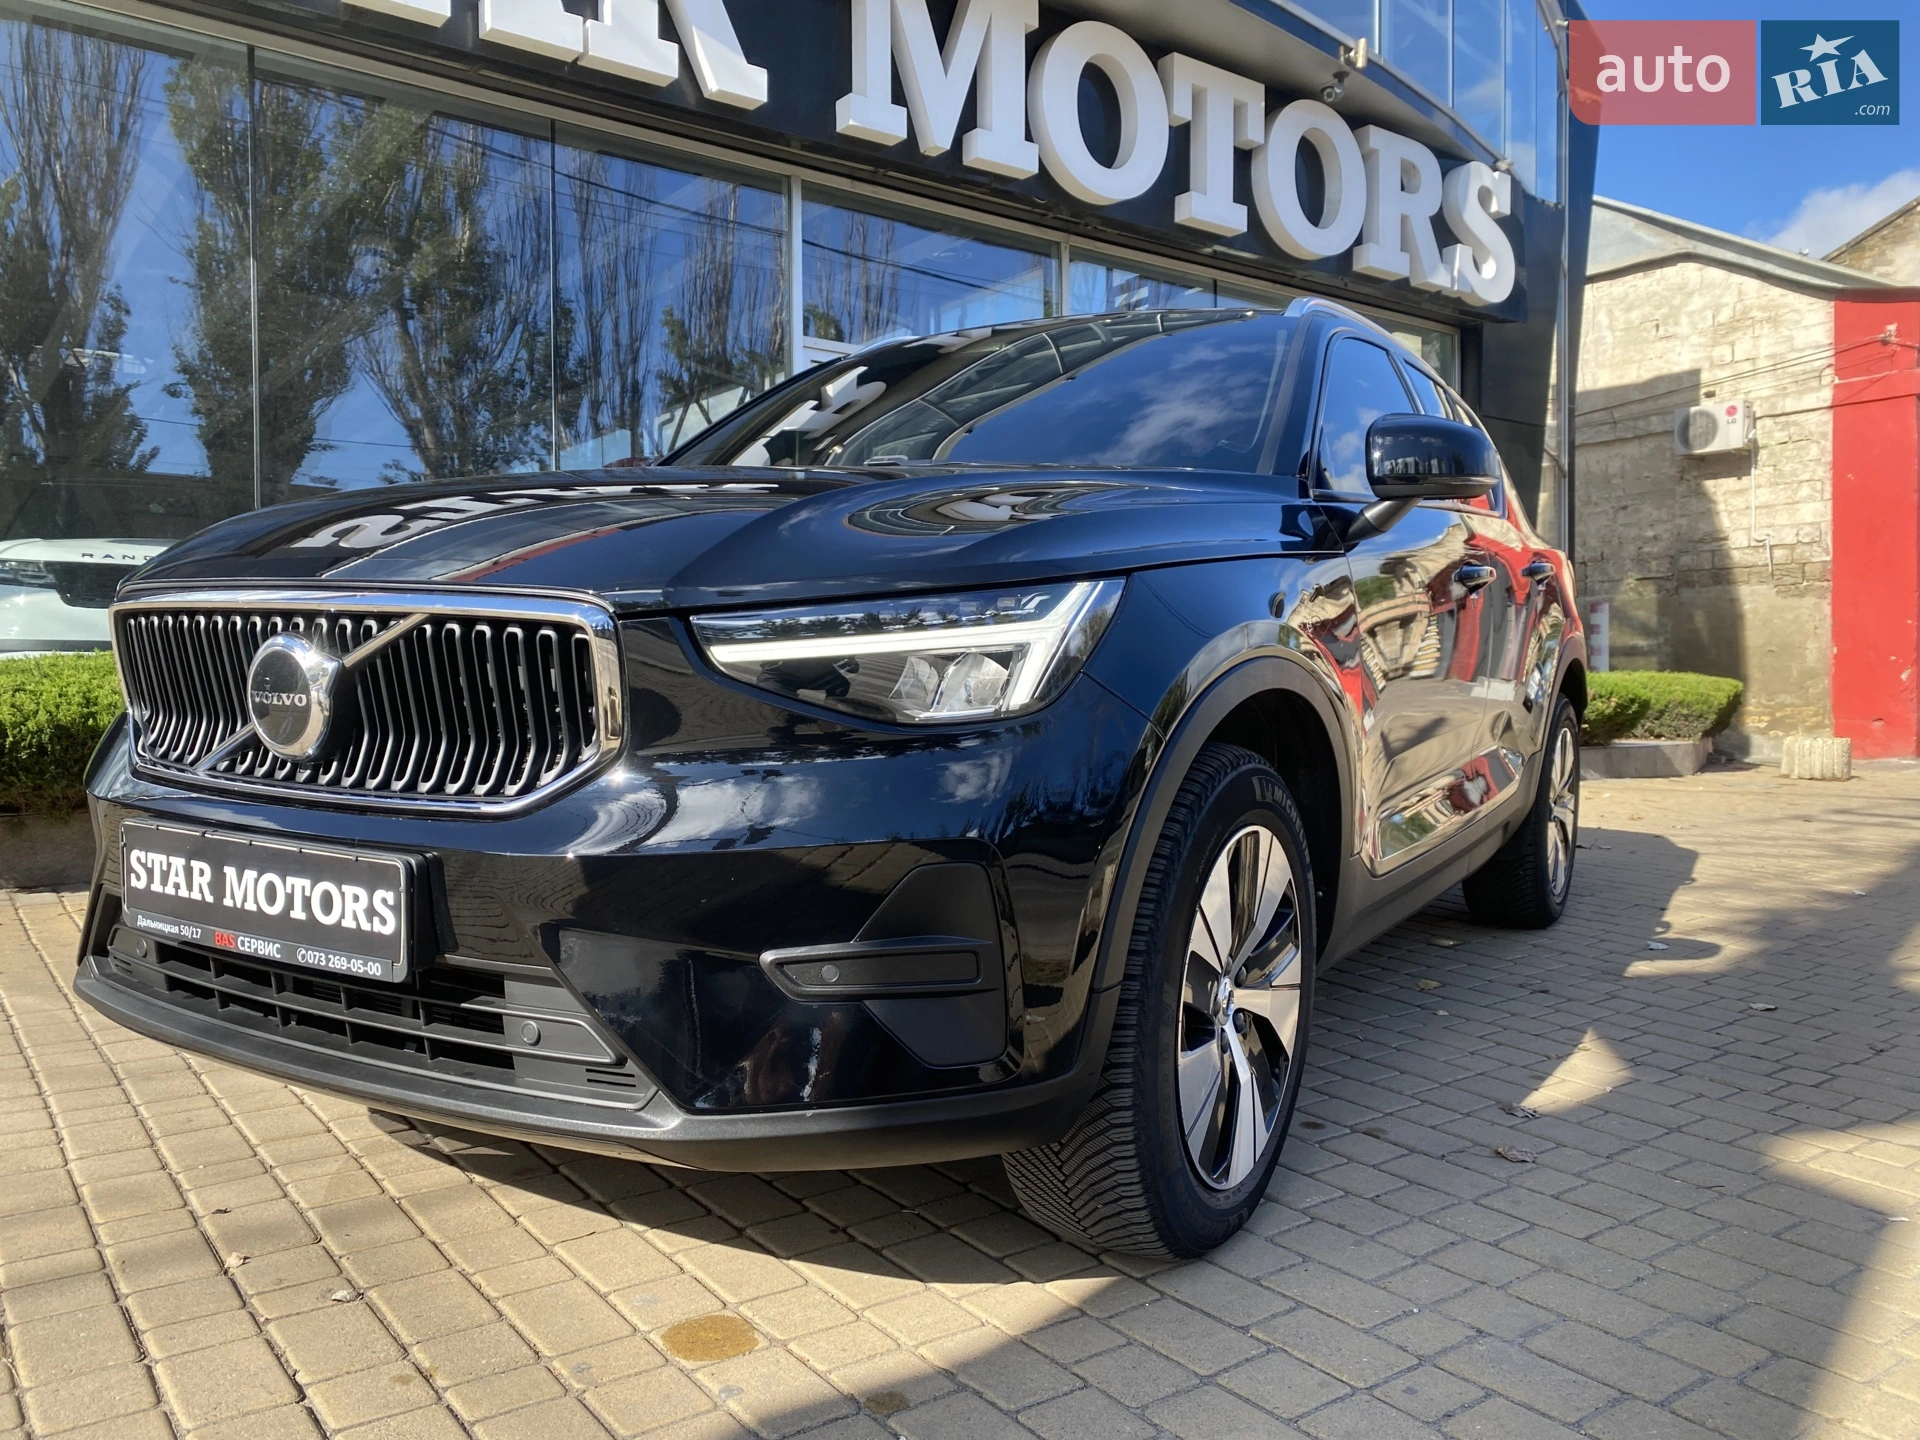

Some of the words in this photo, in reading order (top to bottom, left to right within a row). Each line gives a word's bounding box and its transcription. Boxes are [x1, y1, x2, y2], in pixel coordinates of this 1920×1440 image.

[836, 0, 1516, 306] MOTORS
[1726, 417, 1737, 425] LG
[251, 690, 307, 707] VOLVO
[1273, 784, 1311, 865] MICHELIN
[130, 849, 213, 903] STAR
[223, 865, 396, 936] MOTORS
[136, 914, 179, 934] Дальницкая
[179, 924, 202, 939] 50/17
[214, 931, 236, 949] BAS
[237, 936, 281, 958] СЕРВИС
[307, 950, 326, 966] 073
[328, 954, 381, 976] 269-05-00
